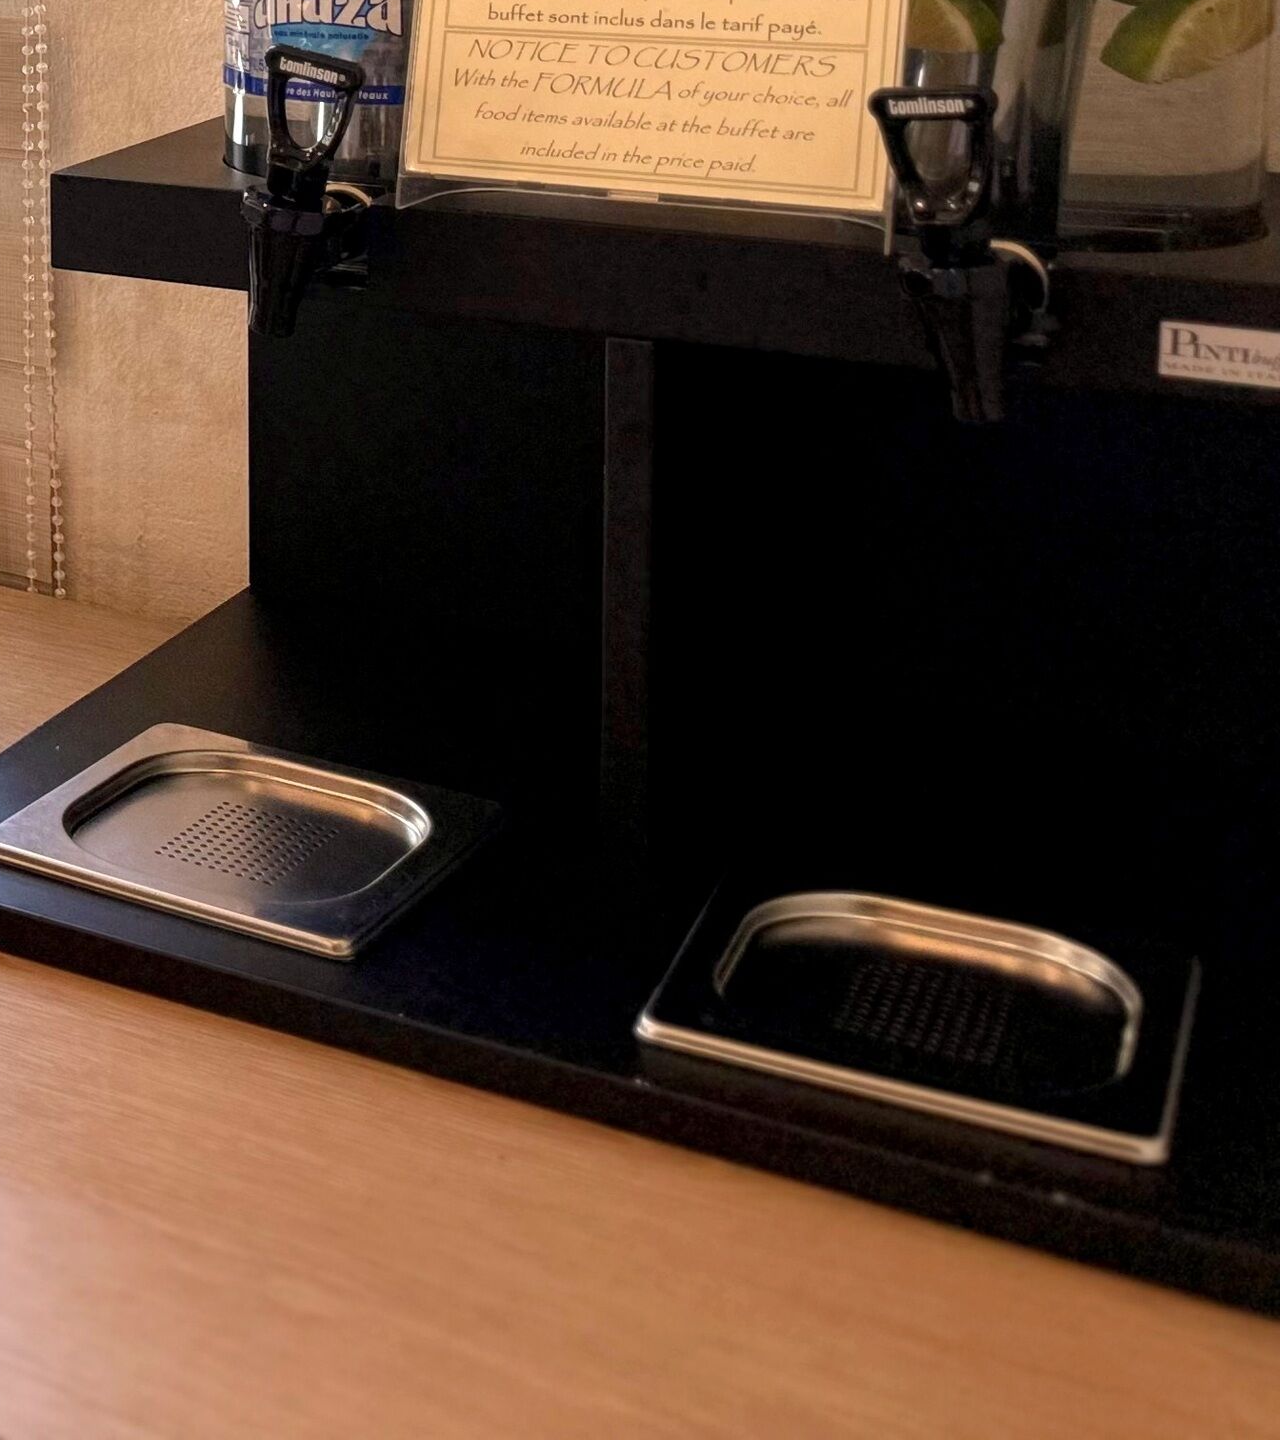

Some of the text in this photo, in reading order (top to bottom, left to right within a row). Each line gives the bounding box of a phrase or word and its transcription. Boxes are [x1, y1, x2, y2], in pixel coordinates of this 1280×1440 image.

[488, 2, 823, 41] buffet sont inclus dans le tarif payé.
[279, 56, 338, 85] tomlinson
[468, 39, 838, 77] NOTICE TO CUSTOMERS
[313, 88, 338, 100] Haut
[454, 68, 854, 109] With the FORMULA of your choice, all
[888, 97, 966, 116] tomlinson
[474, 101, 815, 142] food items available at the buffet are
[520, 140, 757, 179] included in the price paid.
